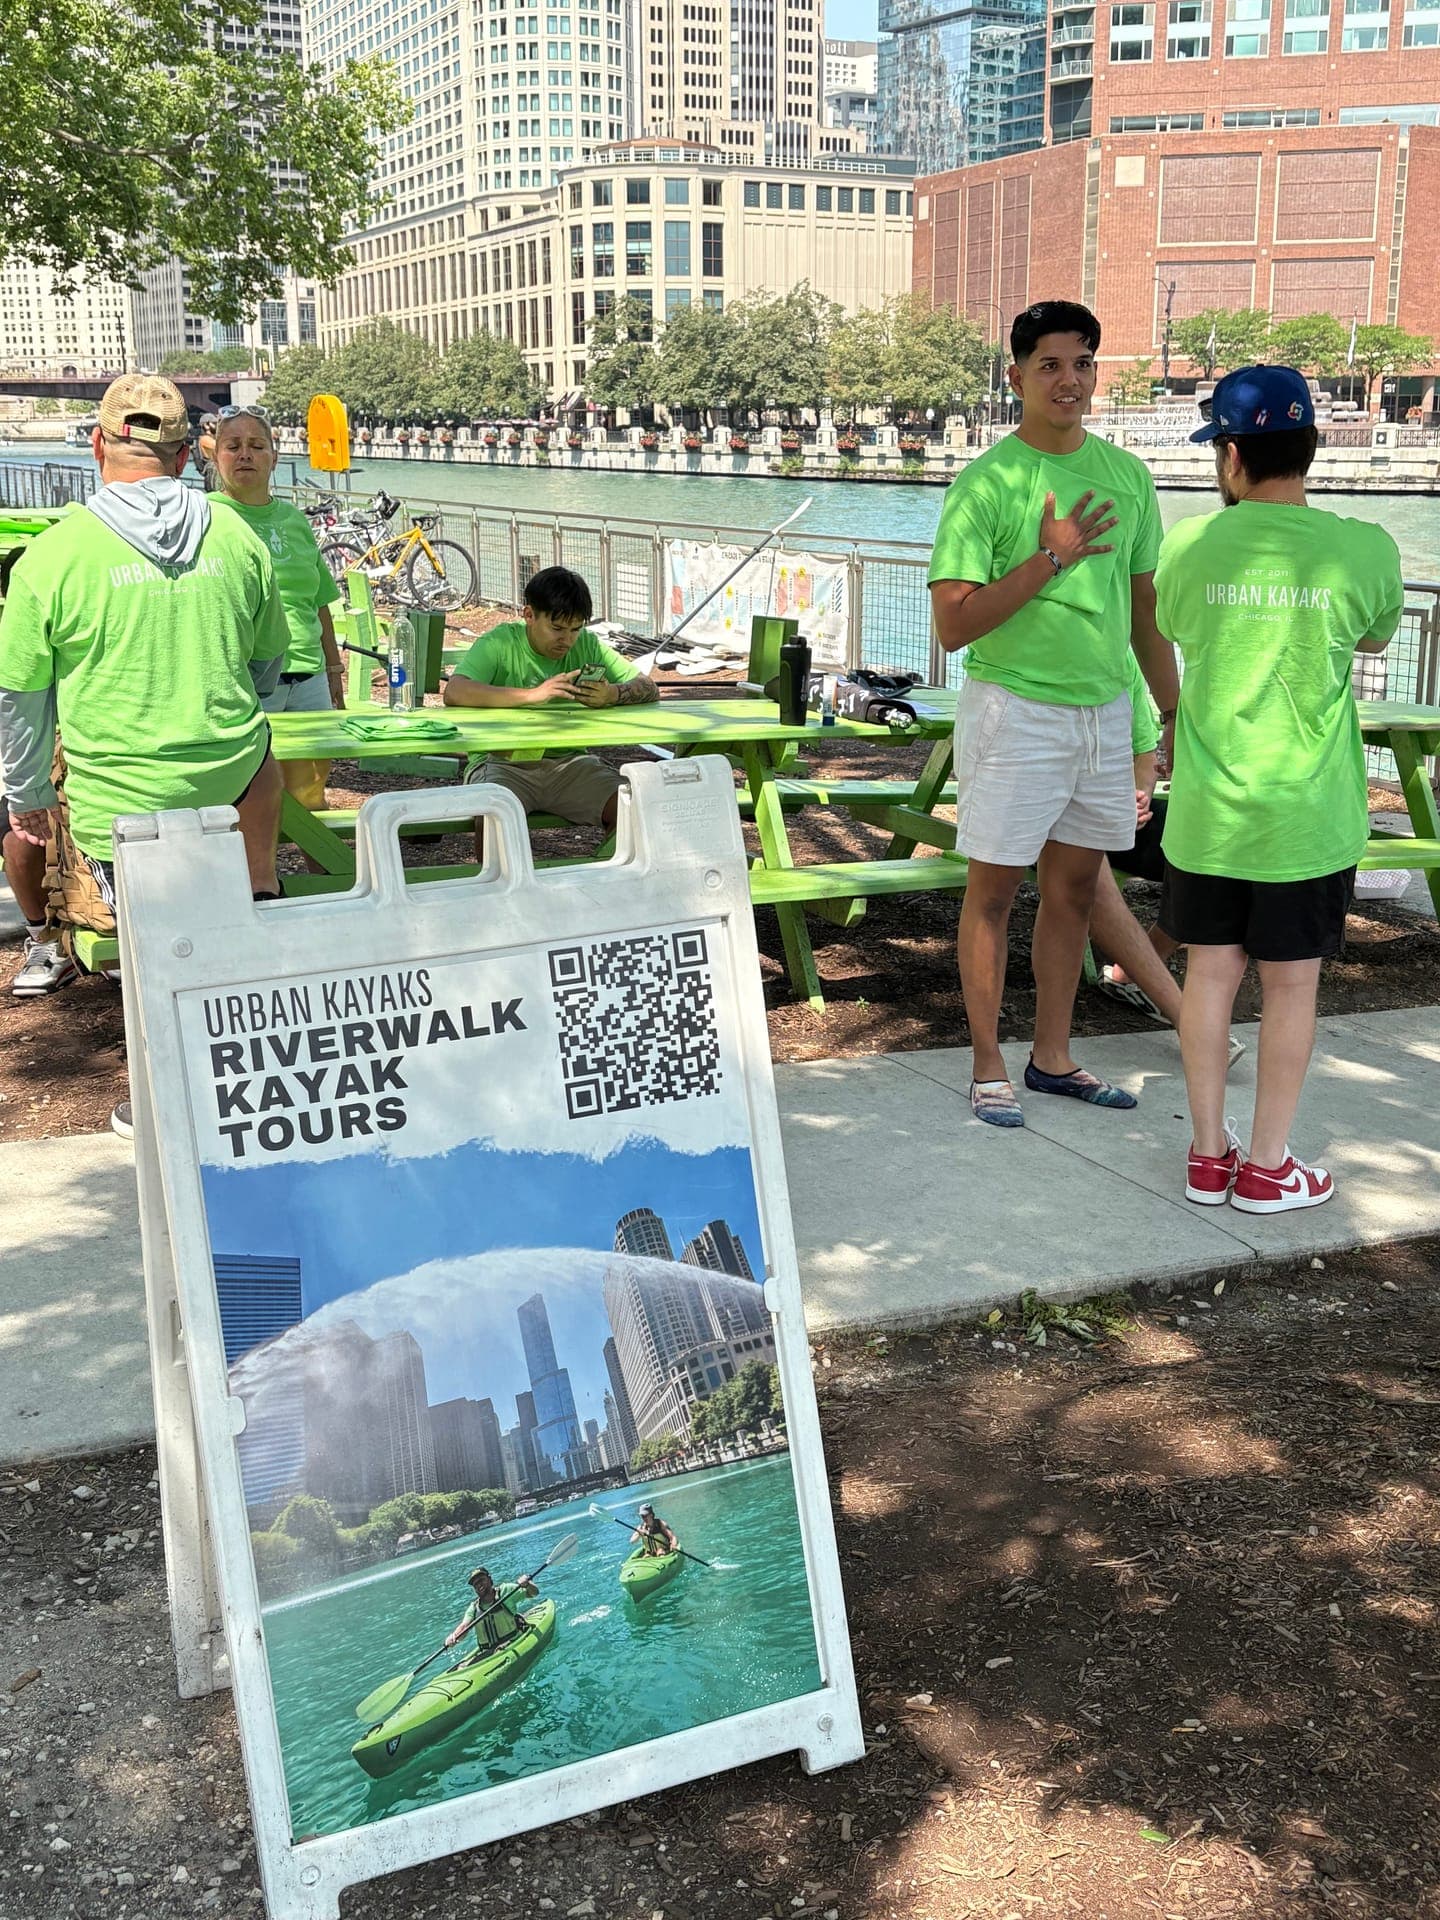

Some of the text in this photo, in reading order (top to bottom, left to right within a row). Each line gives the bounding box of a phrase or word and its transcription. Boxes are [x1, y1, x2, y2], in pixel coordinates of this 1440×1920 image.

[1206, 583, 1332, 610] URBAN KAYAKS
[203, 968, 433, 1038] URBAN KAYAKS
[209, 998, 528, 1078] RIVERWALK
[215, 1055, 408, 1118] KAYAK
[219, 1096, 408, 1158] TOURS
